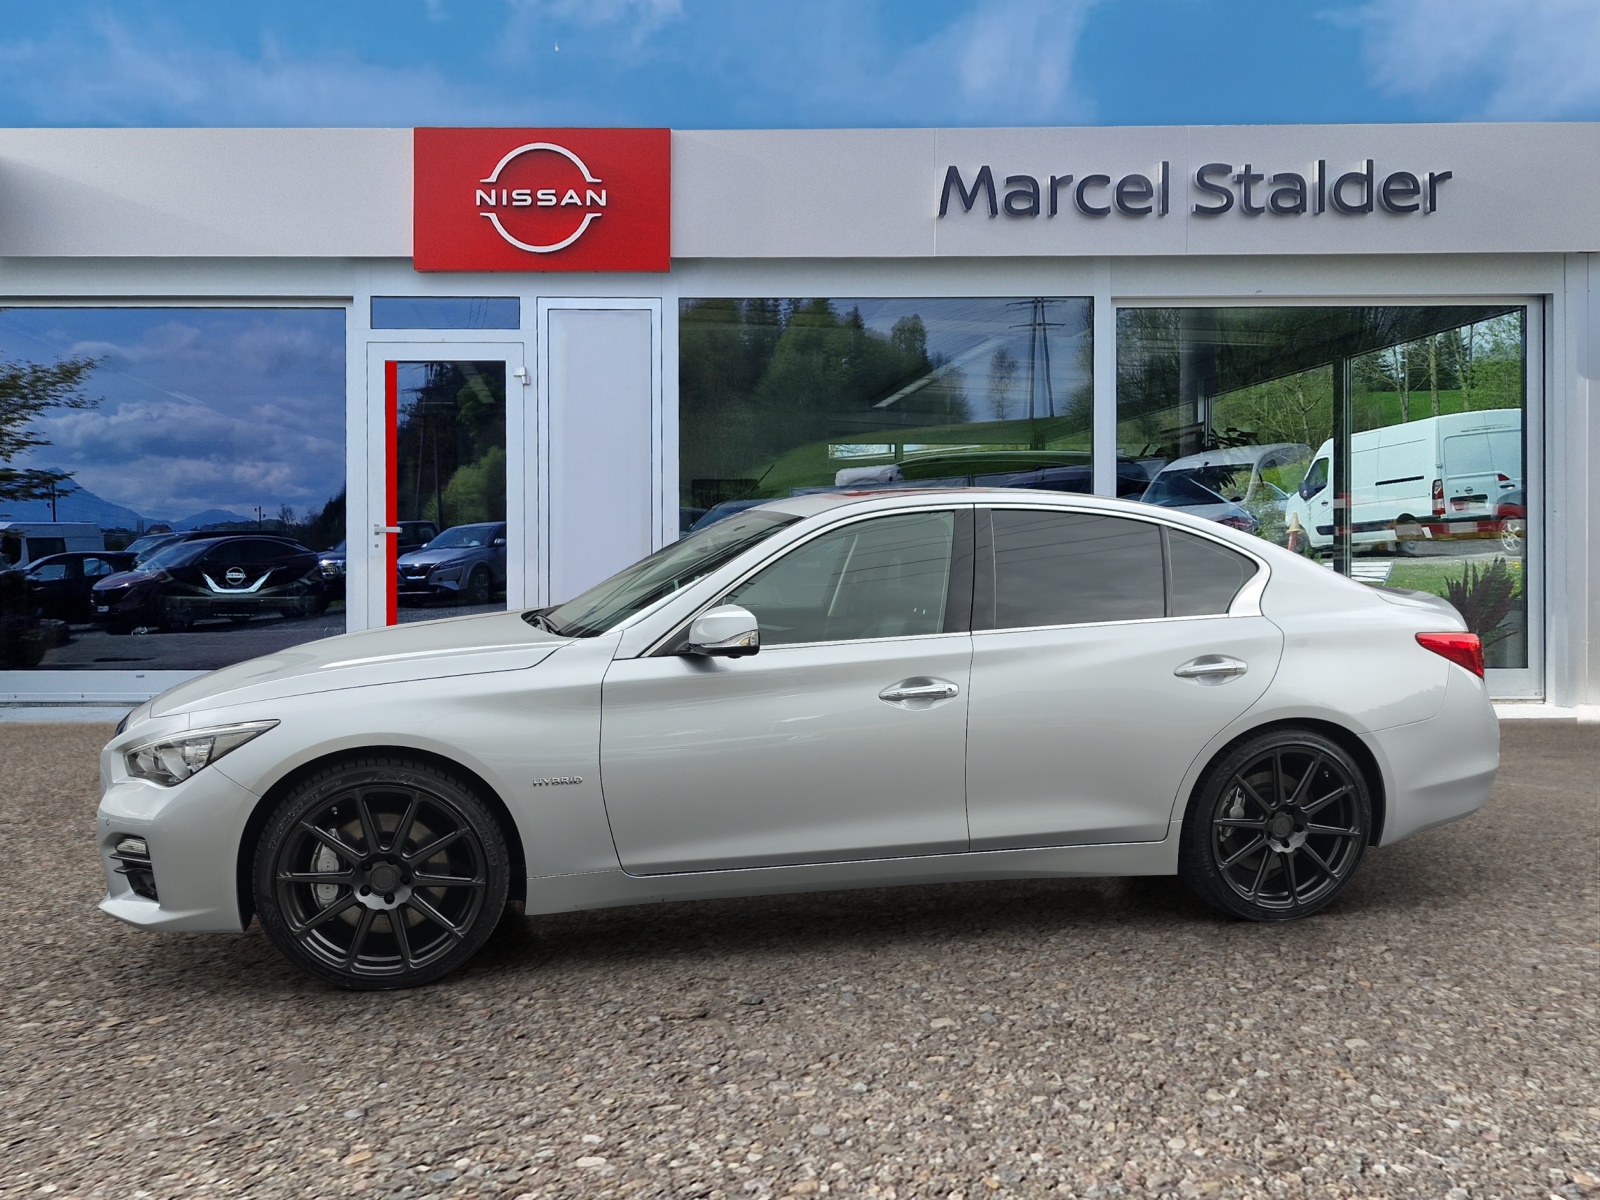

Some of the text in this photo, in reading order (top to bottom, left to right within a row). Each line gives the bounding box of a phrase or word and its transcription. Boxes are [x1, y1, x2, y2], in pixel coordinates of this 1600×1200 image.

[937, 159, 1453, 217] Marcel Stalder
[475, 189, 607, 206] NISSAN
[533, 776, 583, 787] HYBRID
